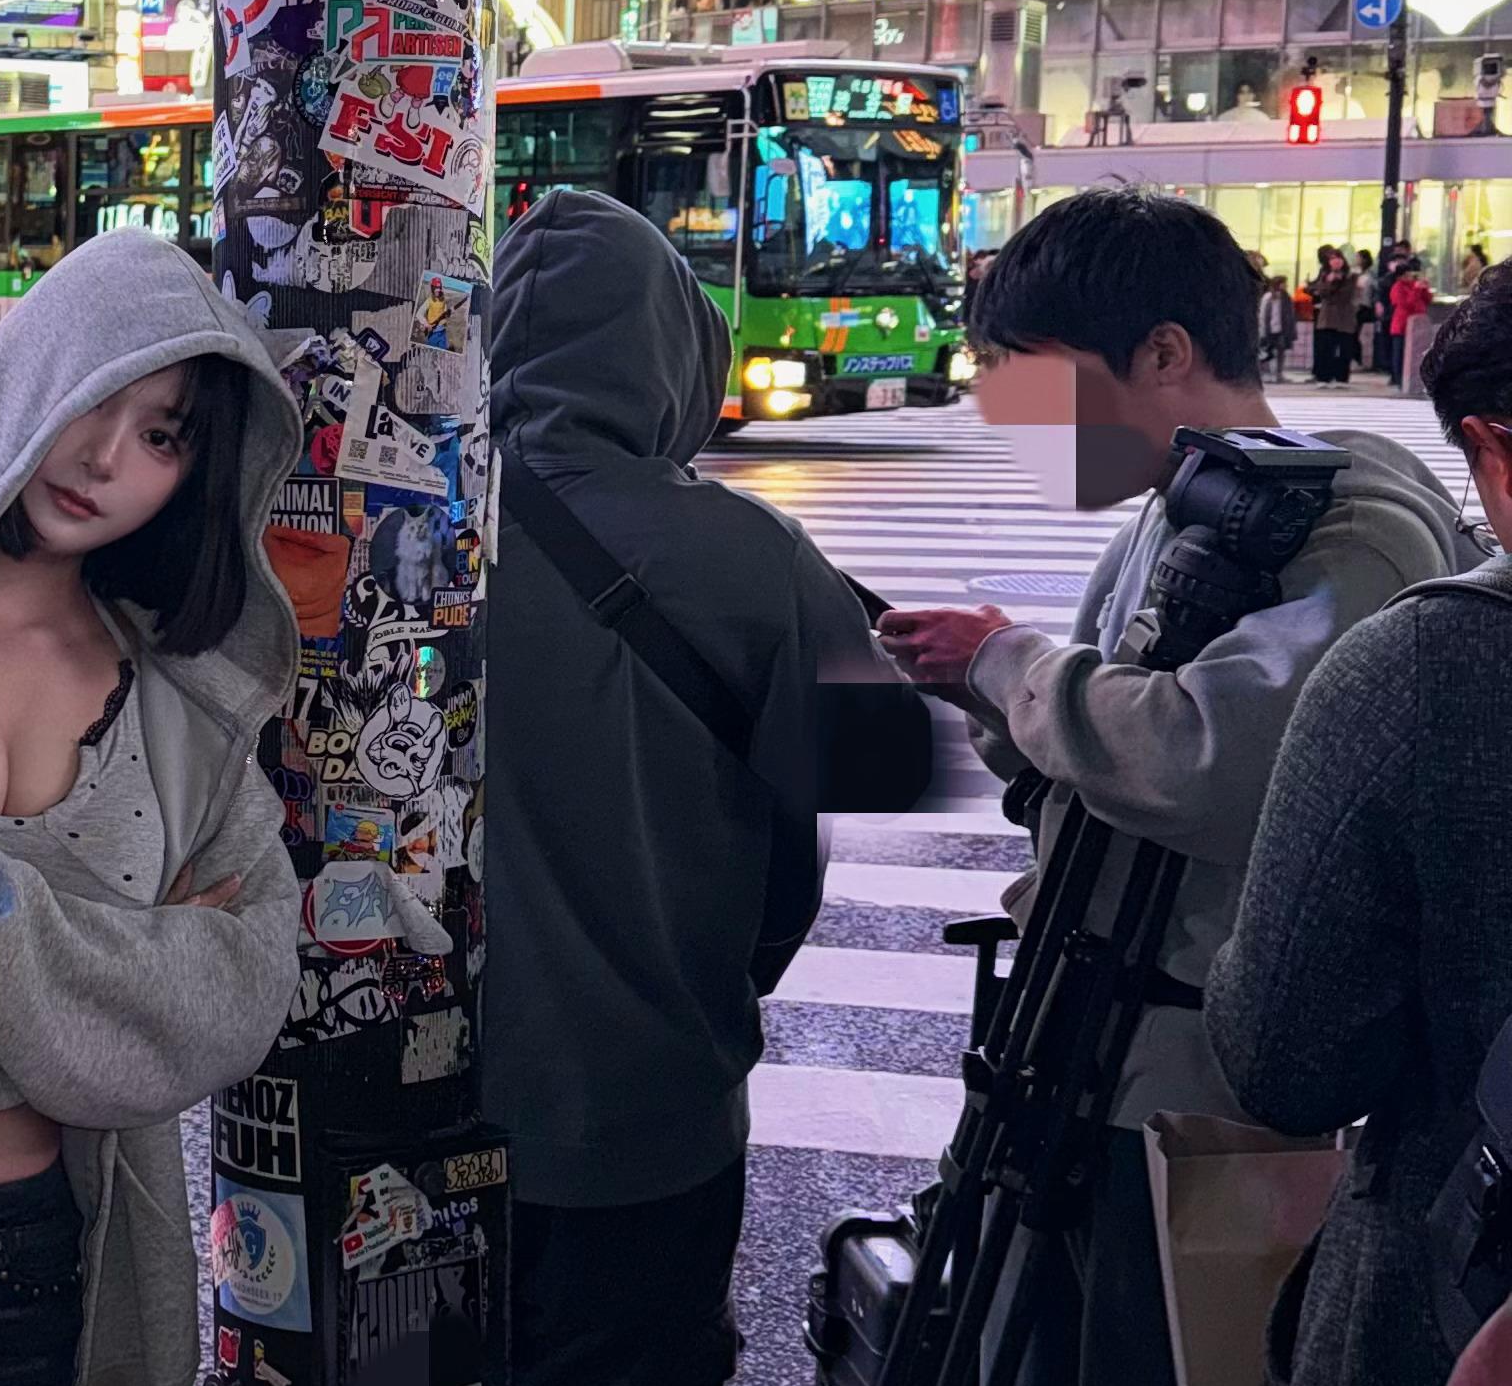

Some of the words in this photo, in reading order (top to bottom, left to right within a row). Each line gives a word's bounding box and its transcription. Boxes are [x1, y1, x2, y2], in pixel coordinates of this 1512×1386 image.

[842, 354, 916, 373] ノンステップバス
[274, 484, 335, 513] NIMAL
